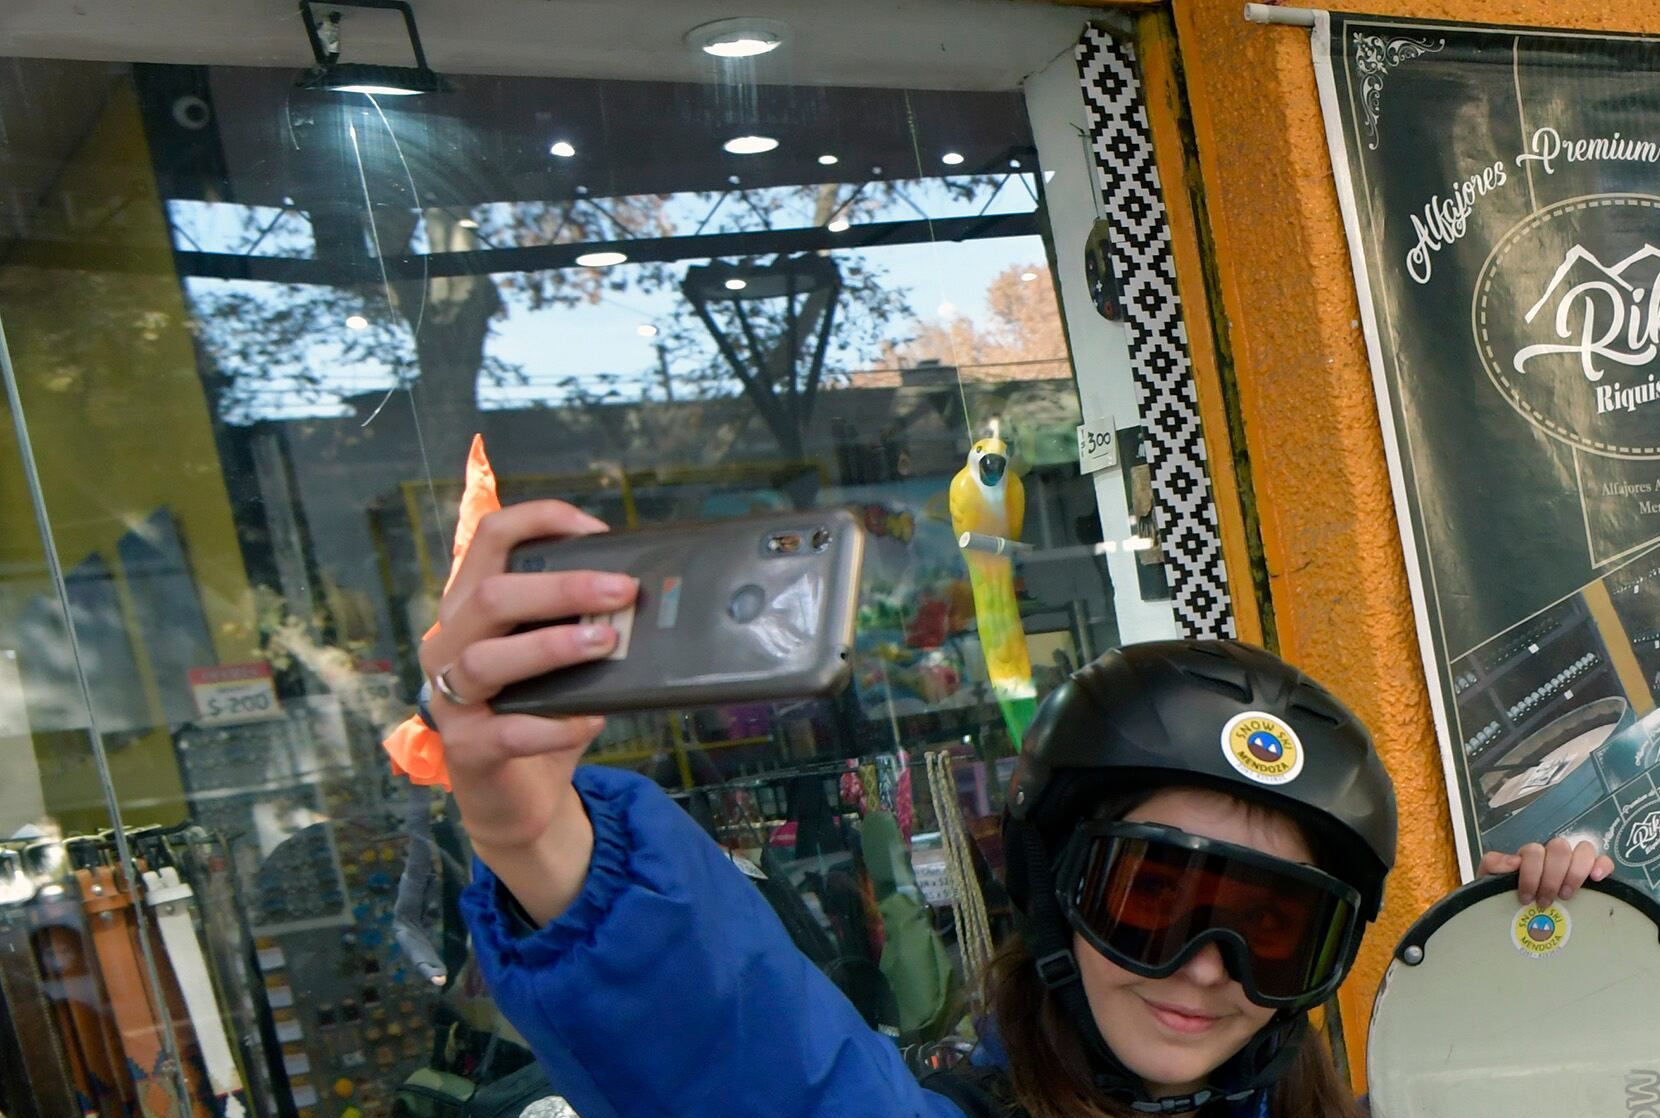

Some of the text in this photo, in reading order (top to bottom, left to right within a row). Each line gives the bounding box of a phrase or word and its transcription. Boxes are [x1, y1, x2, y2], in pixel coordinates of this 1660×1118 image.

[1406, 164, 1508, 284] Alfajores
[1601, 482, 1652, 498] Alfajores
[1235, 720, 1293, 751] SNOW SKI
[1236, 750, 1290, 774] MENDOZA
[1548, 908, 1564, 924] SKI
[1520, 935, 1563, 952] MENDOZA
